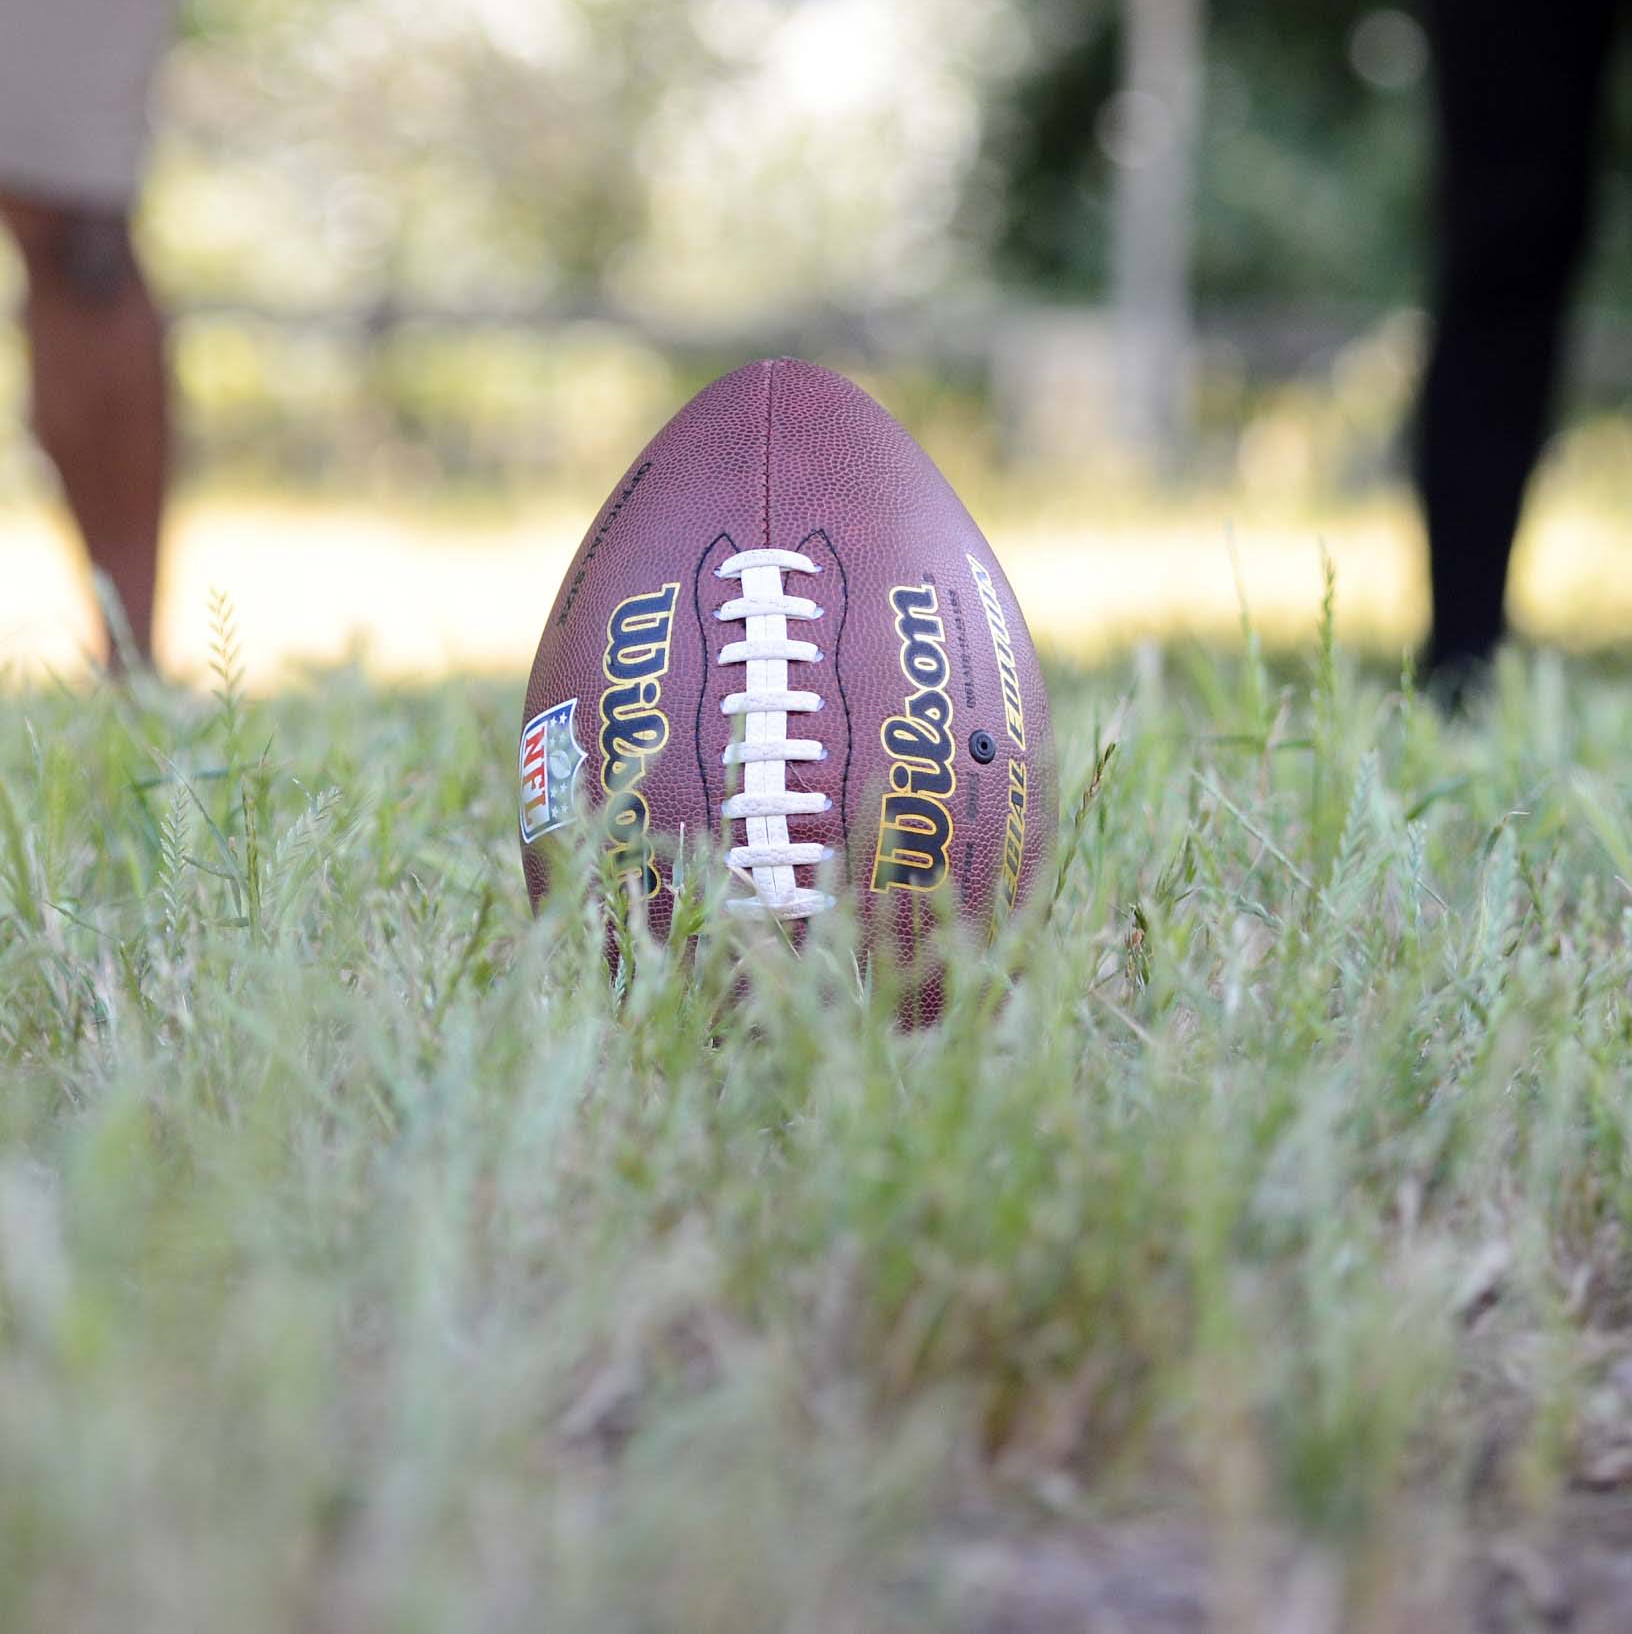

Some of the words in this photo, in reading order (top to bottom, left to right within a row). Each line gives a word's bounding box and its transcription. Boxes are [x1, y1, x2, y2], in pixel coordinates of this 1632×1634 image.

[582, 462, 653, 565] OFFICIAL
[599, 582, 681, 898] Wilson
[870, 584, 956, 893] Wilson
[966, 553, 1026, 751] EDITION
[523, 727, 547, 826] NFL
[986, 757, 1027, 949] ECIAL
